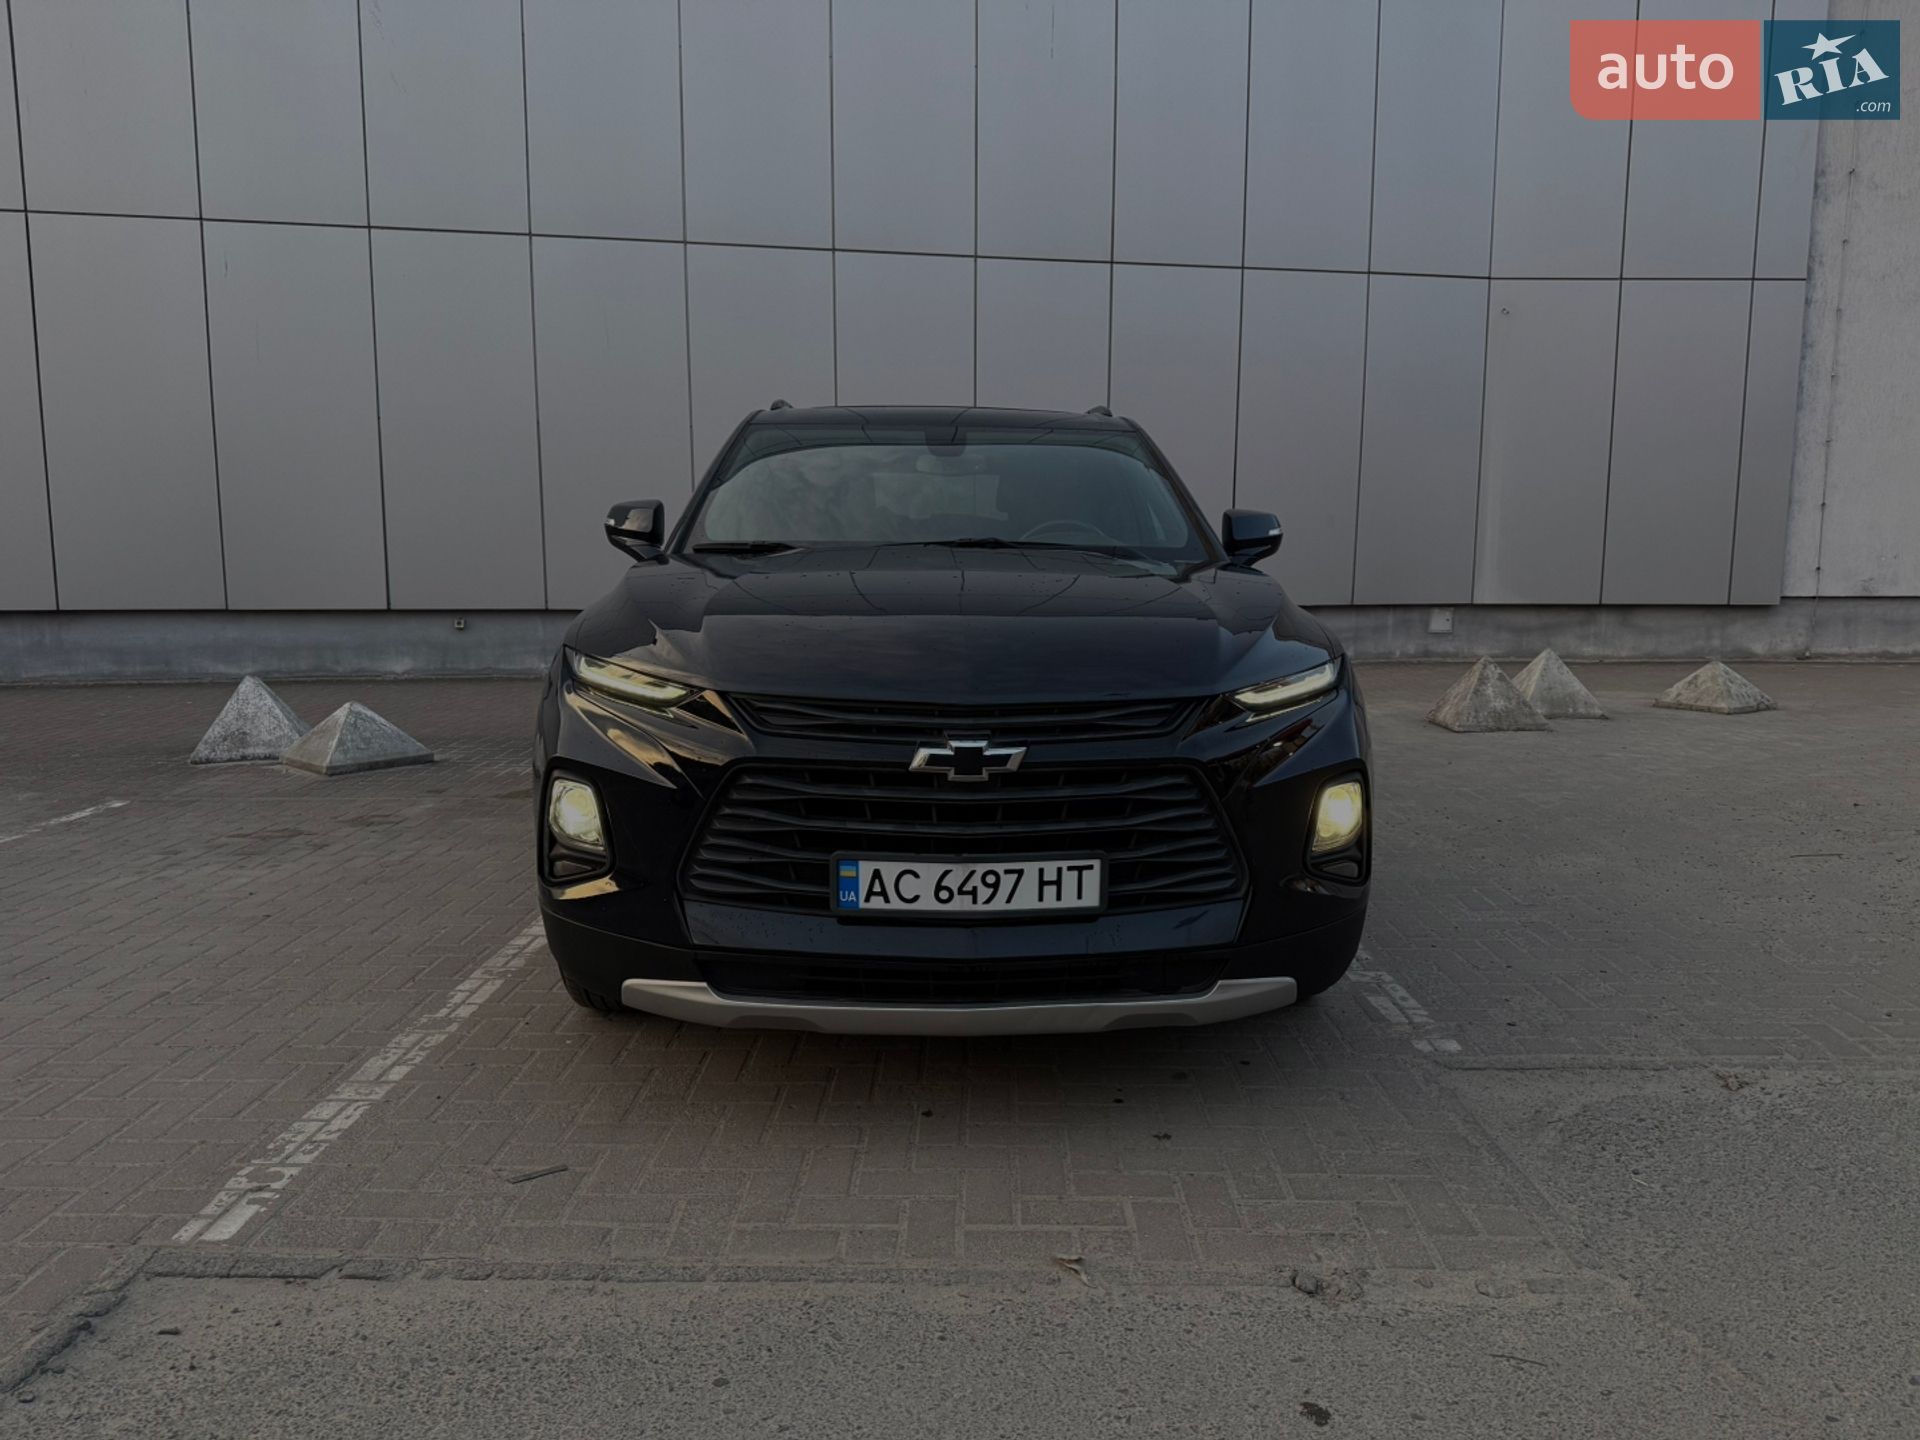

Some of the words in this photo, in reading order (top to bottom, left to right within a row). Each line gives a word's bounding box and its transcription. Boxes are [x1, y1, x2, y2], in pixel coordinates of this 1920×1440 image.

[839, 890, 857, 902] UA
[863, 868, 921, 904] AC
[933, 868, 1025, 905] 6497
[1037, 864, 1094, 902] HT
